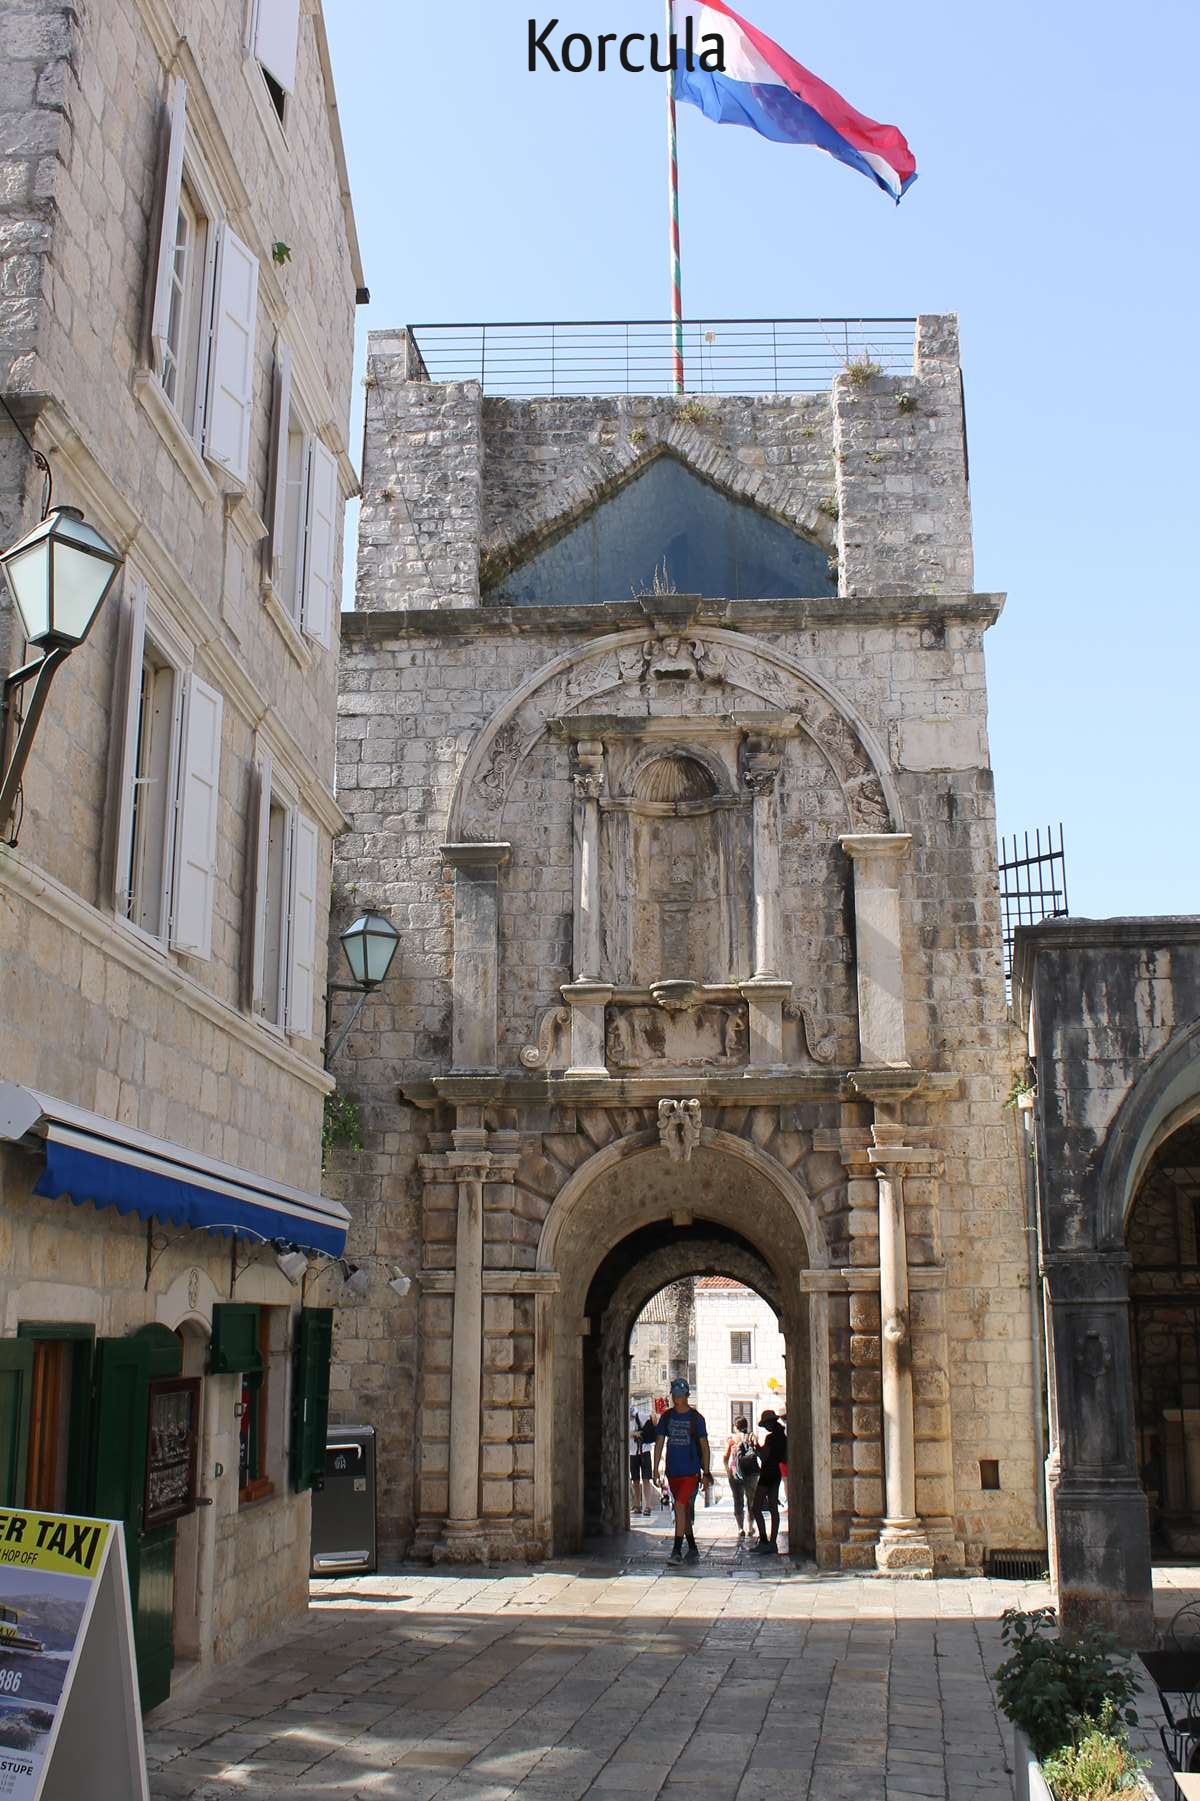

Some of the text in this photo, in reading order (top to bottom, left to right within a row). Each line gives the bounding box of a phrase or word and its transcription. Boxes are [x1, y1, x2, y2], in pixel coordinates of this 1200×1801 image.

[36, 1519, 101, 1570] TAXI
[1, 1548, 39, 1565] HOP OFF
[0, 1761, 33, 1776] STUPE
